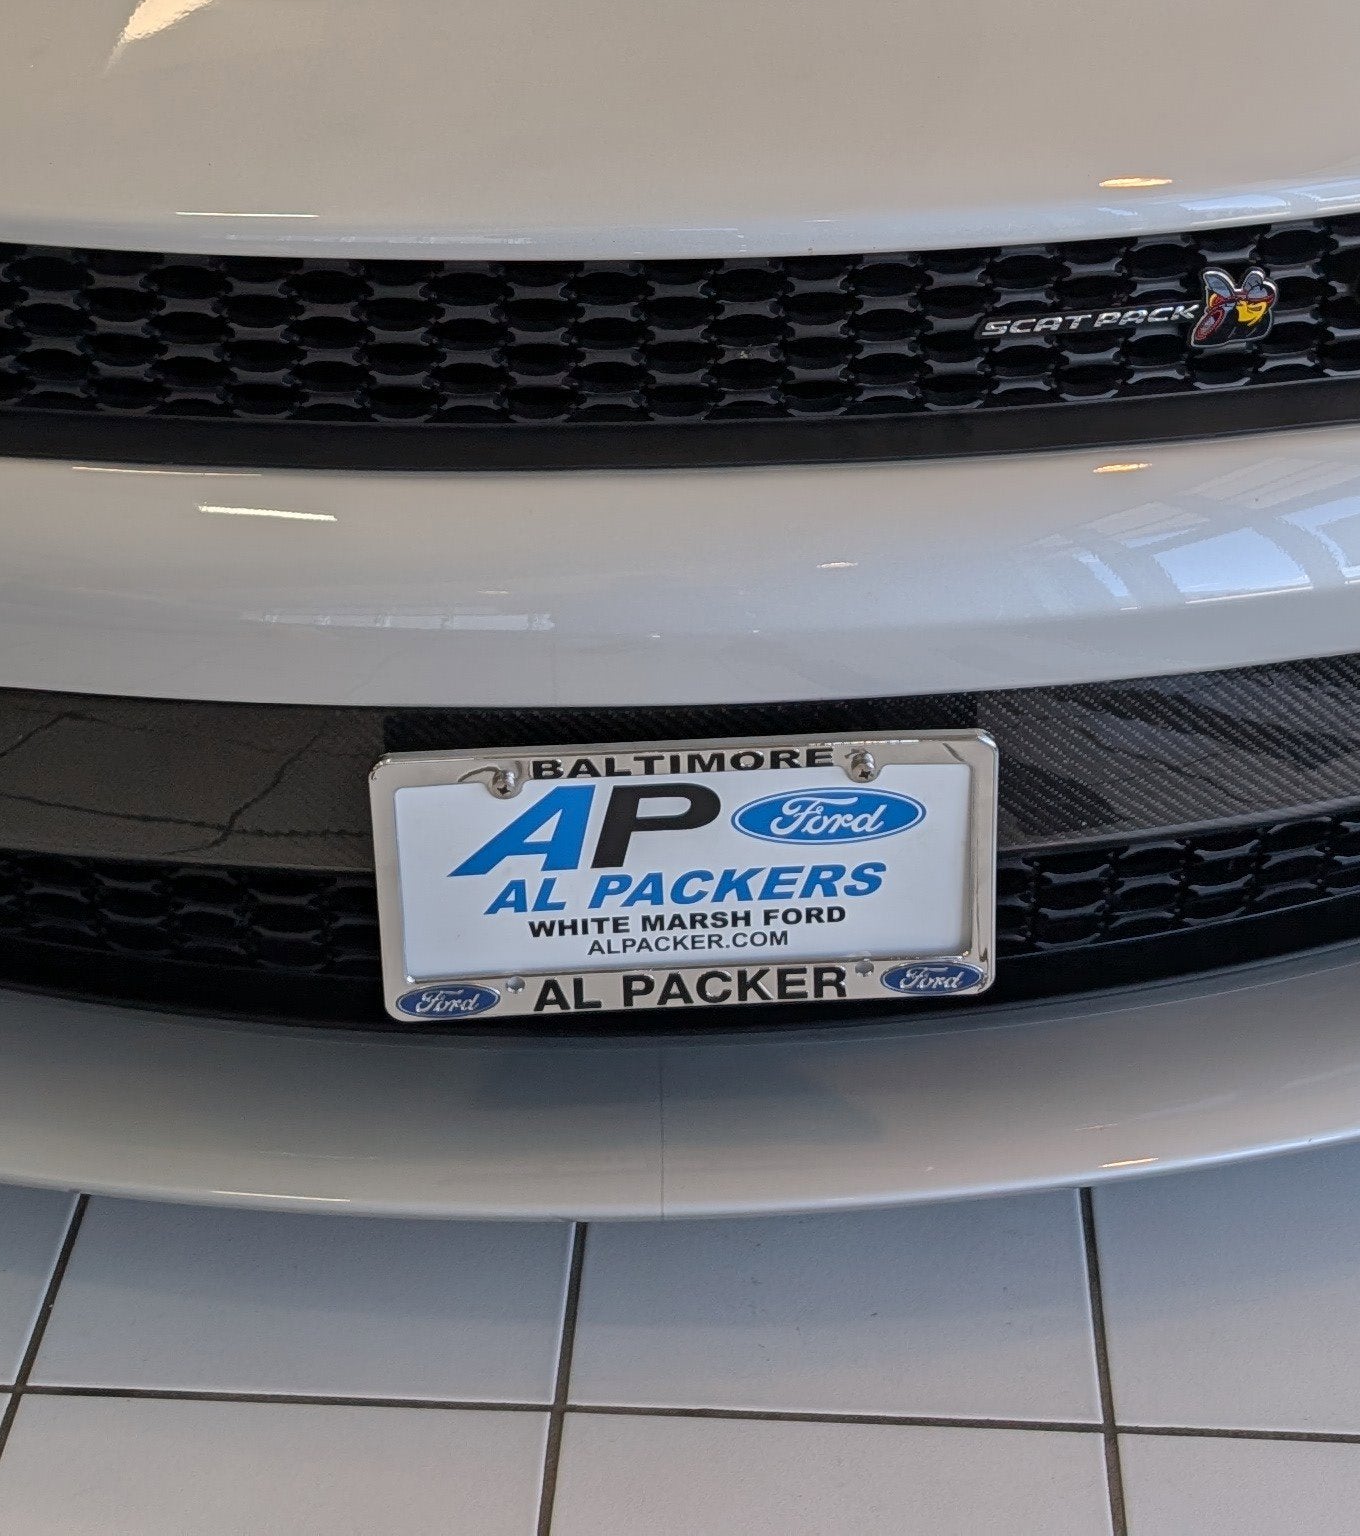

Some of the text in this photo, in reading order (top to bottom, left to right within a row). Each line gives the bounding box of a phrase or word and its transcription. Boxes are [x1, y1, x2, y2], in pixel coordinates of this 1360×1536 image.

[981, 303, 1201, 337] SCAT PACK
[530, 746, 836, 781] BALTIMORE
[446, 782, 723, 878] AP
[769, 795, 888, 837] Ford
[483, 861, 888, 915] AL PACKERS
[528, 905, 846, 938] WHITE MARSH FORD
[587, 930, 789, 956] ALPACKER.COM
[533, 965, 848, 1012] AL PACKER
[899, 966, 965, 991] Ford
[414, 988, 479, 1014] Ford
